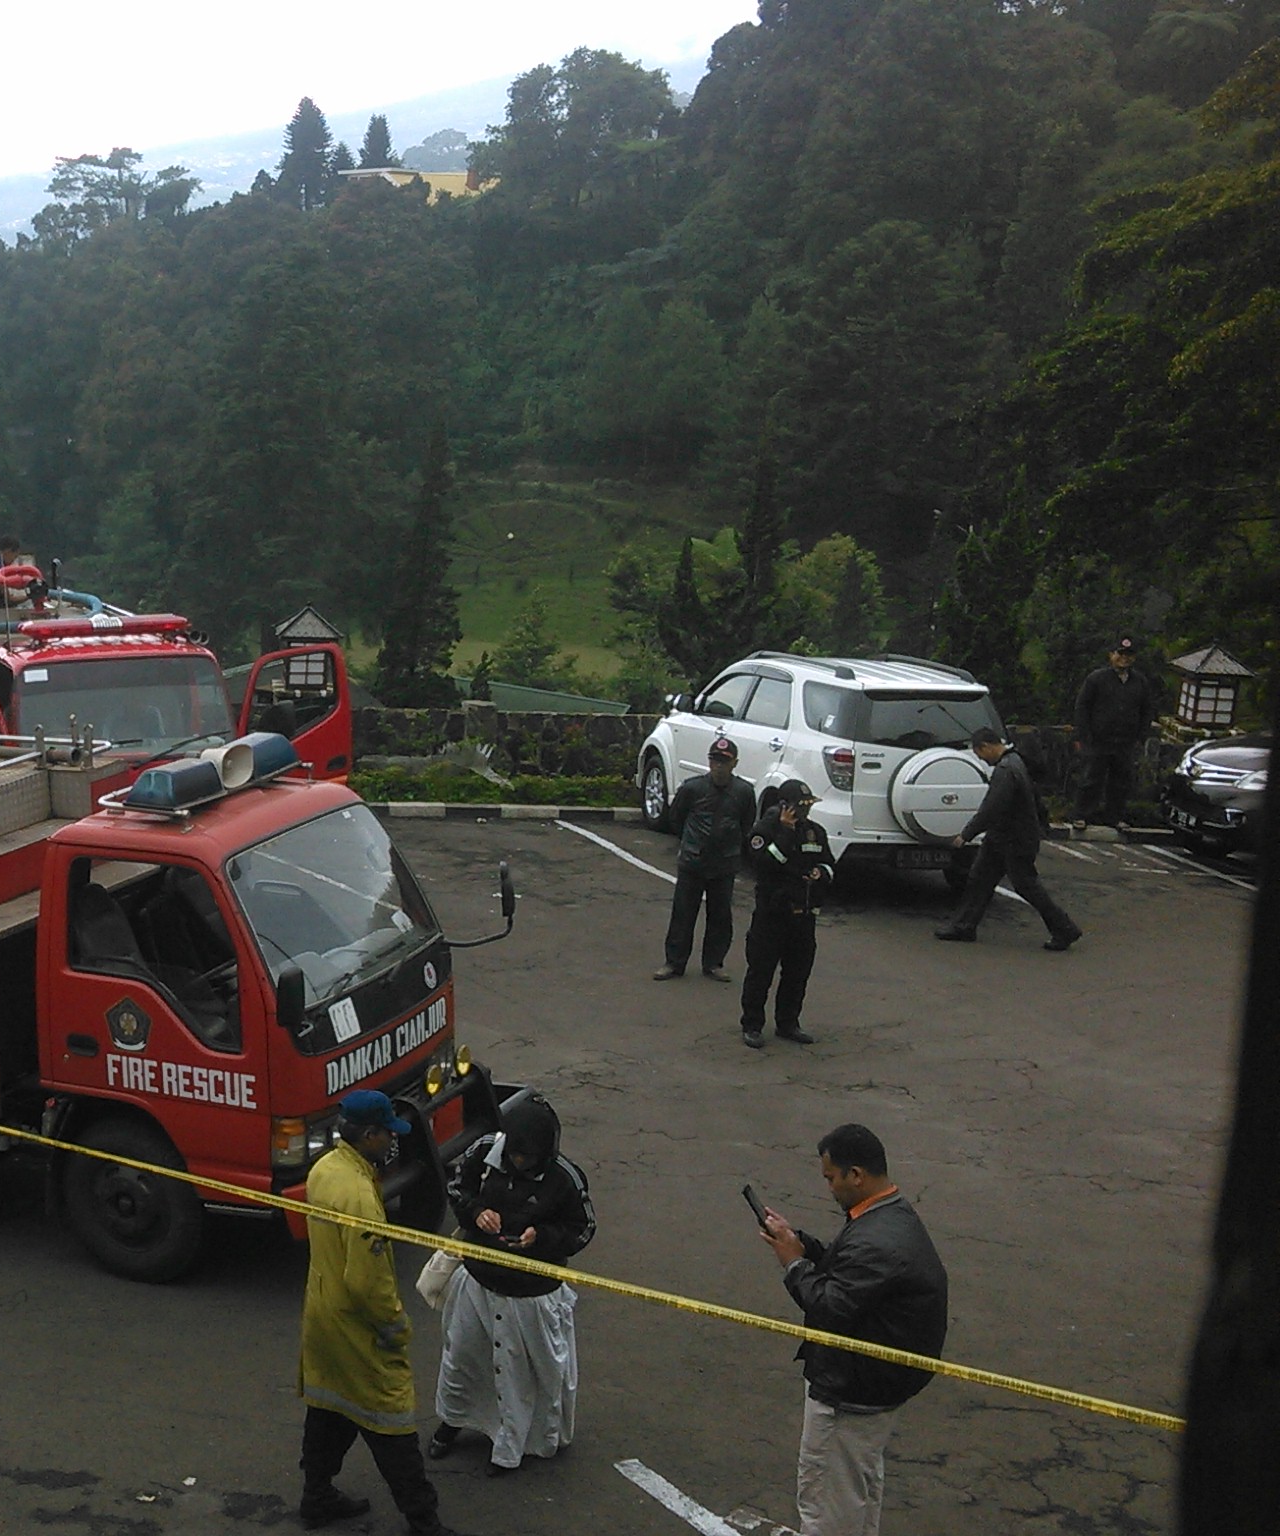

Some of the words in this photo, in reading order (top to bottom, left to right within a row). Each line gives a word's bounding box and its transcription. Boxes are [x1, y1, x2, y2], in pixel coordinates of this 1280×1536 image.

[107, 1054, 159, 1093] FIRE
[162, 1062, 257, 1109] RESCUE
[327, 1034, 392, 1096] DAMKAR
[396, 997, 447, 1058] CIANJUR
